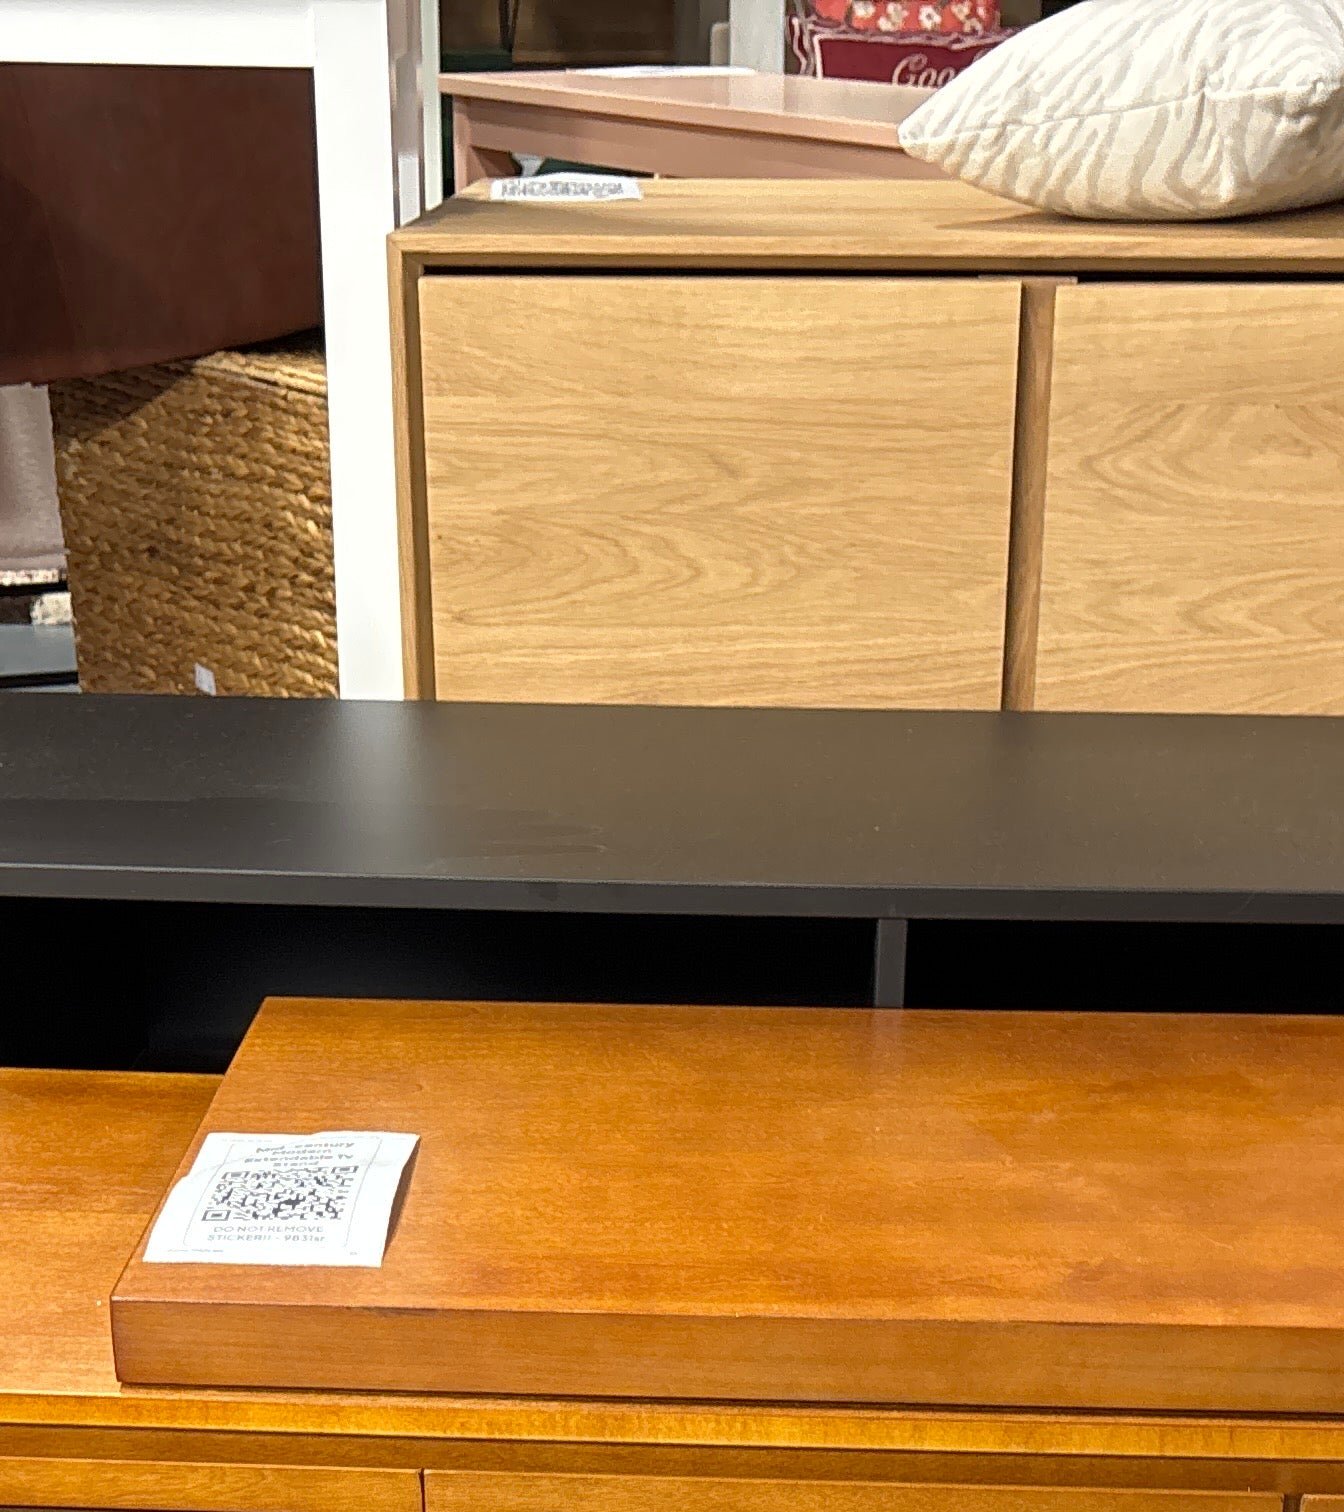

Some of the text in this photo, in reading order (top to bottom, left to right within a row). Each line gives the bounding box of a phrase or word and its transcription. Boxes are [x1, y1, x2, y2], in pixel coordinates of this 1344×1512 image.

[213, 1225, 324, 1233] DO NOT REMOVE
